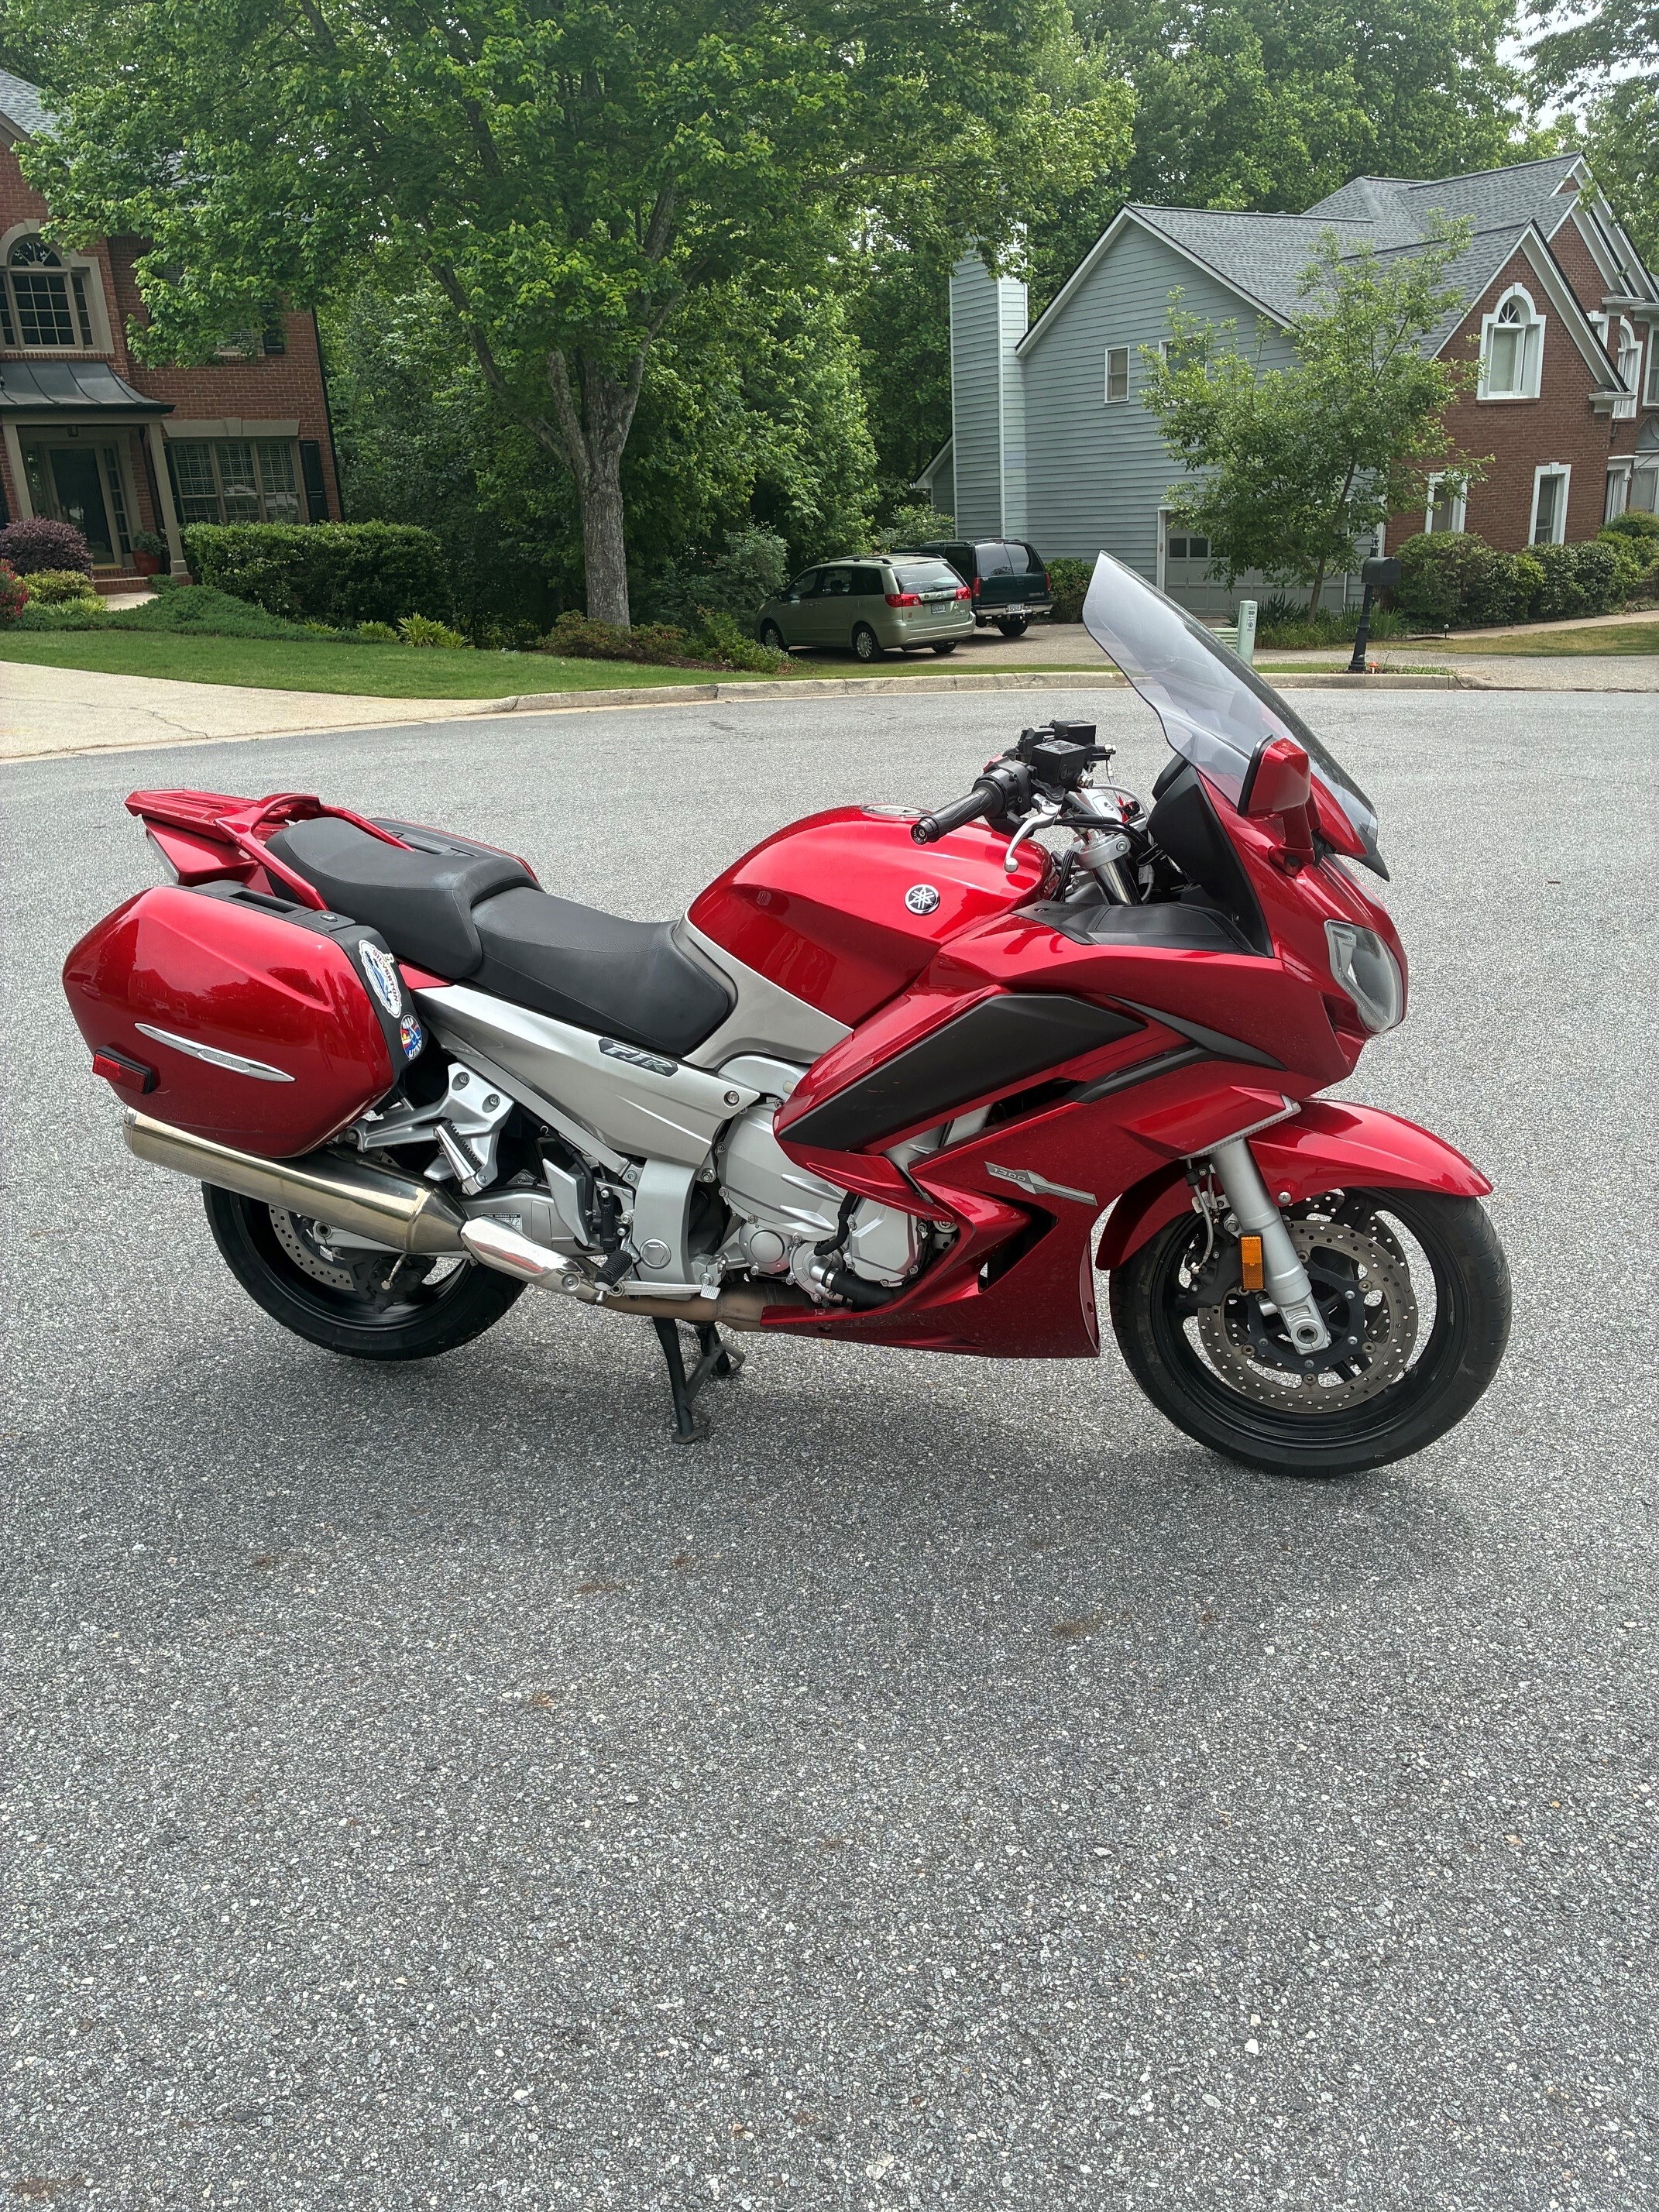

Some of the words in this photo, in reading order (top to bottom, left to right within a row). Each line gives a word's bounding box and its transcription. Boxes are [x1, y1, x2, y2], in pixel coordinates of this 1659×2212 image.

[372, 950, 400, 1003] SILVERTON
[603, 1042, 673, 1075] FJR
[994, 1167, 1026, 1182] 1300
